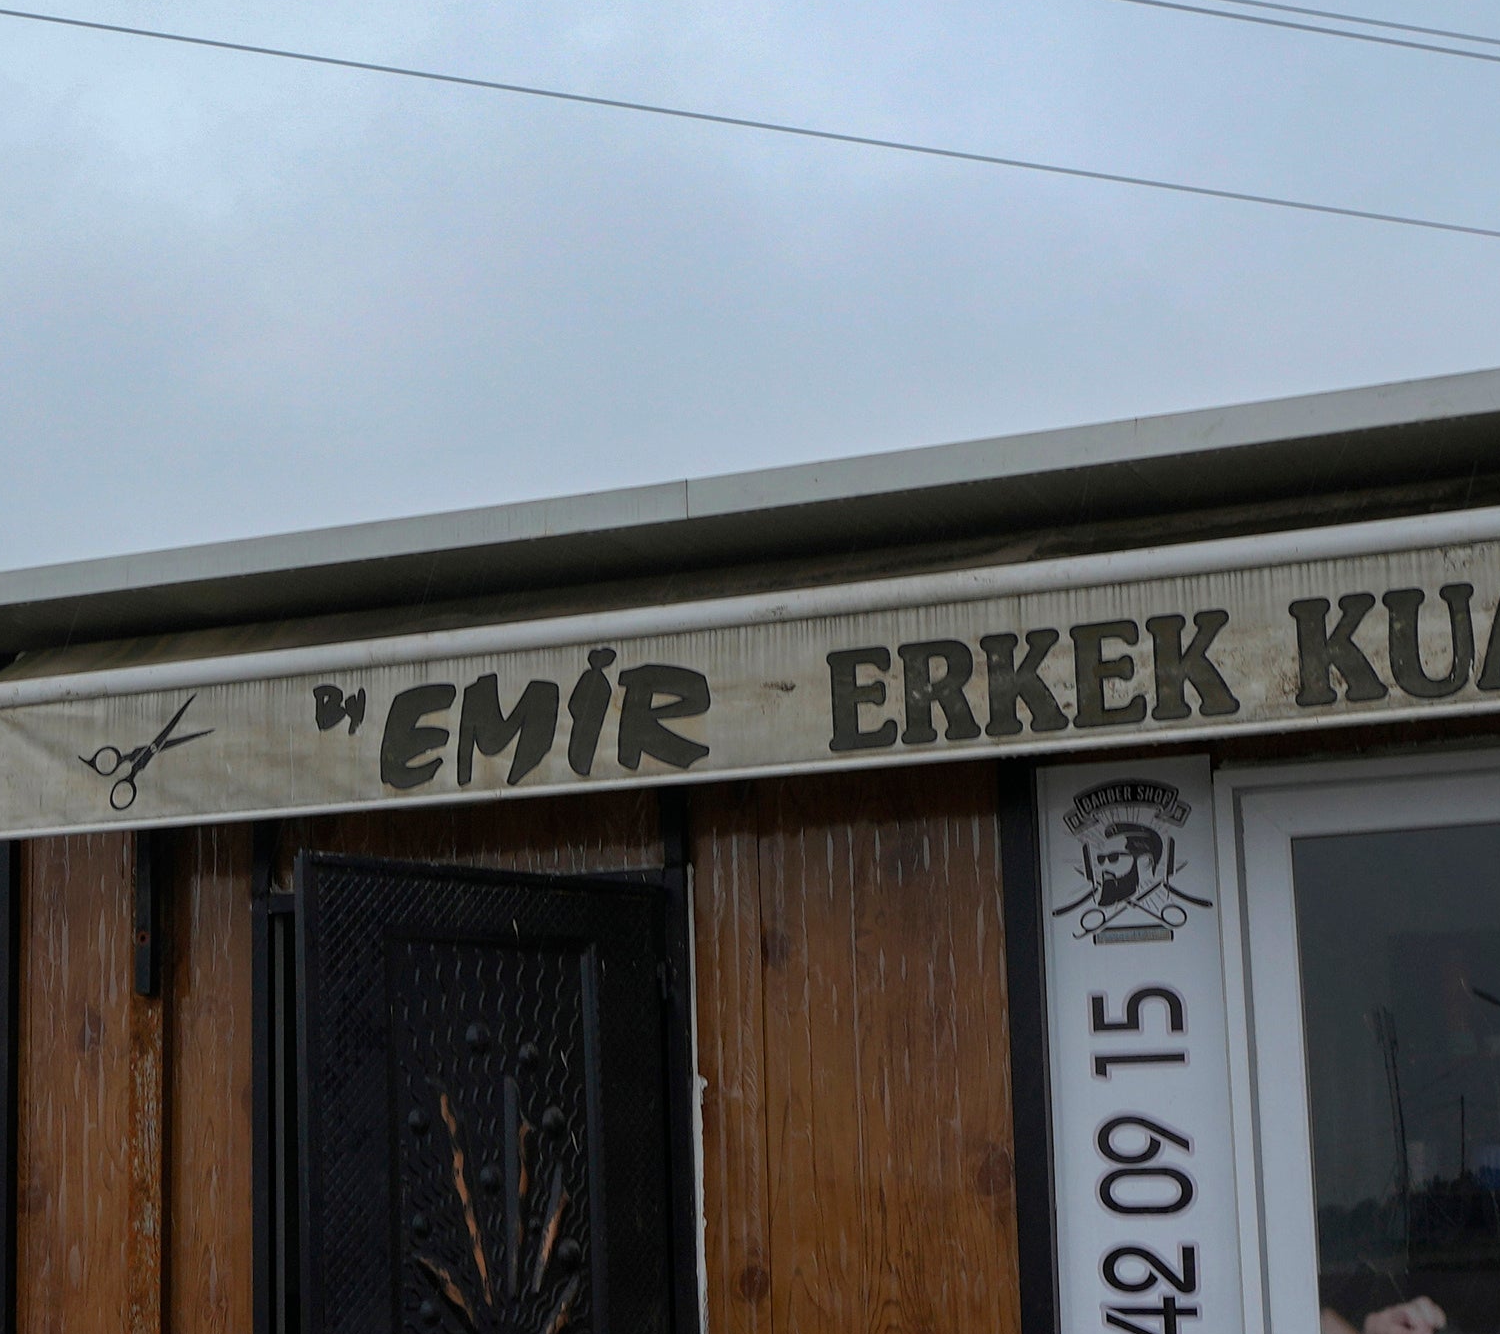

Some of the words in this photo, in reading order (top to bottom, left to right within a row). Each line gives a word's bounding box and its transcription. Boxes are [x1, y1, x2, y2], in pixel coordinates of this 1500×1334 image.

[313, 683, 366, 736] By
[380, 647, 711, 789] EMİR
[826, 609, 1241, 751] ERKEK
[1082, 785, 1132, 811] BARBER
[1136, 785, 1173, 809] SHOP
[1091, 987, 1187, 1079] 15
[1097, 1116, 1194, 1215] 09
